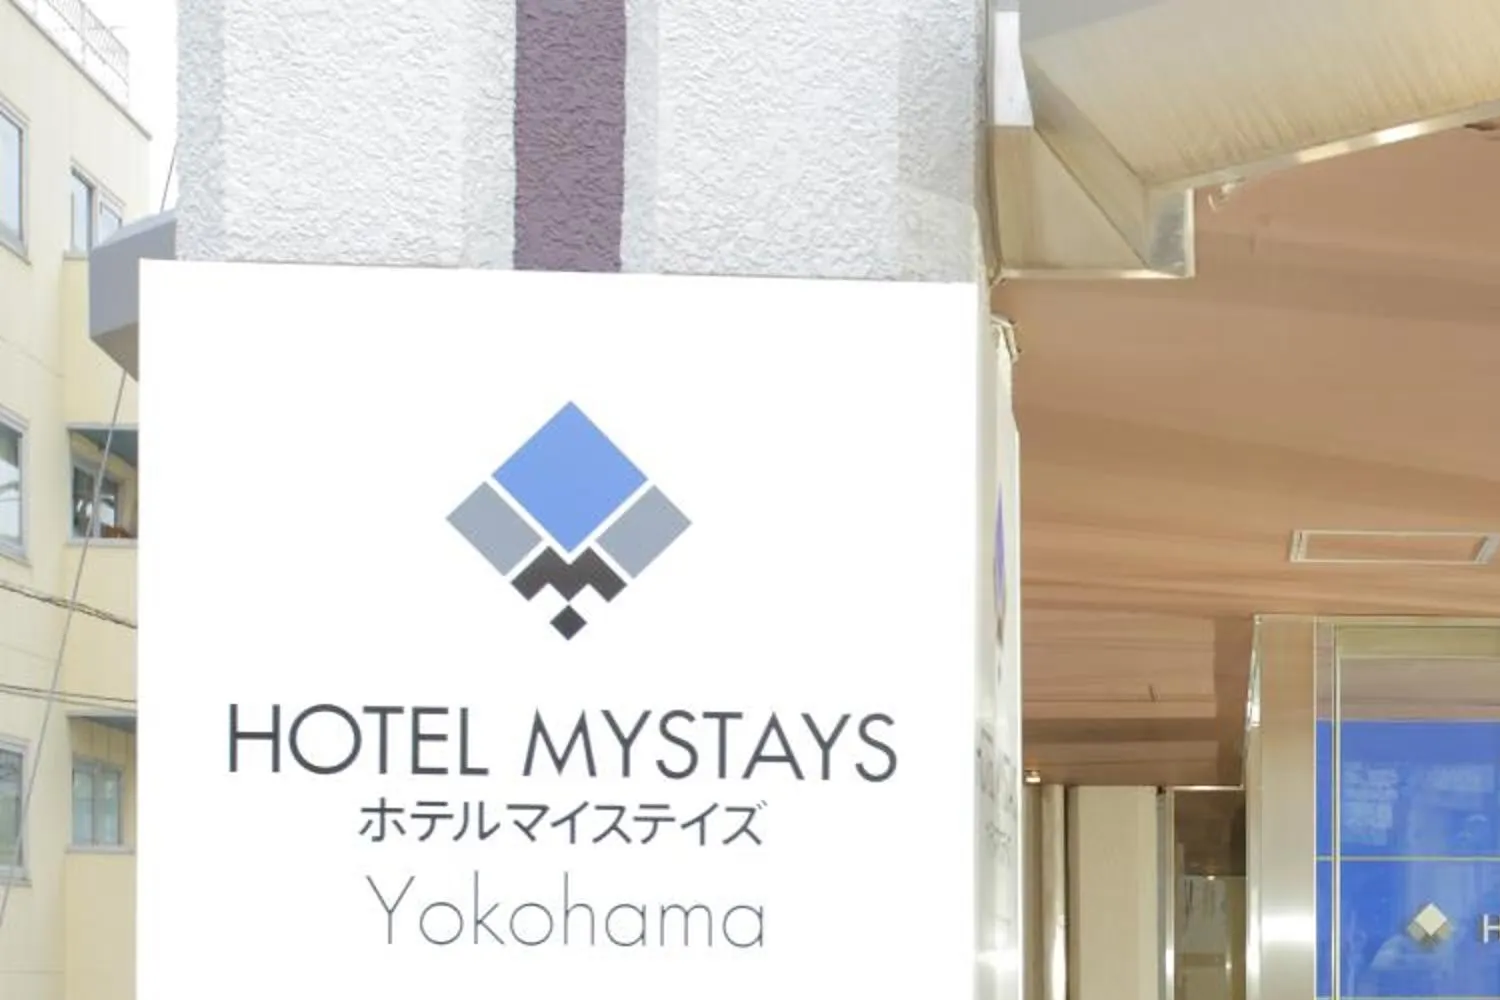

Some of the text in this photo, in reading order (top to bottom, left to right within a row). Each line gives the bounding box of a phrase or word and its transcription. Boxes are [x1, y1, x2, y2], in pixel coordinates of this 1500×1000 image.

[228, 703, 898, 783] HOTEL MYSTAYS
[358, 797, 768, 847] ホテルマイステイズ
[366, 870, 764, 948] Yokohama
